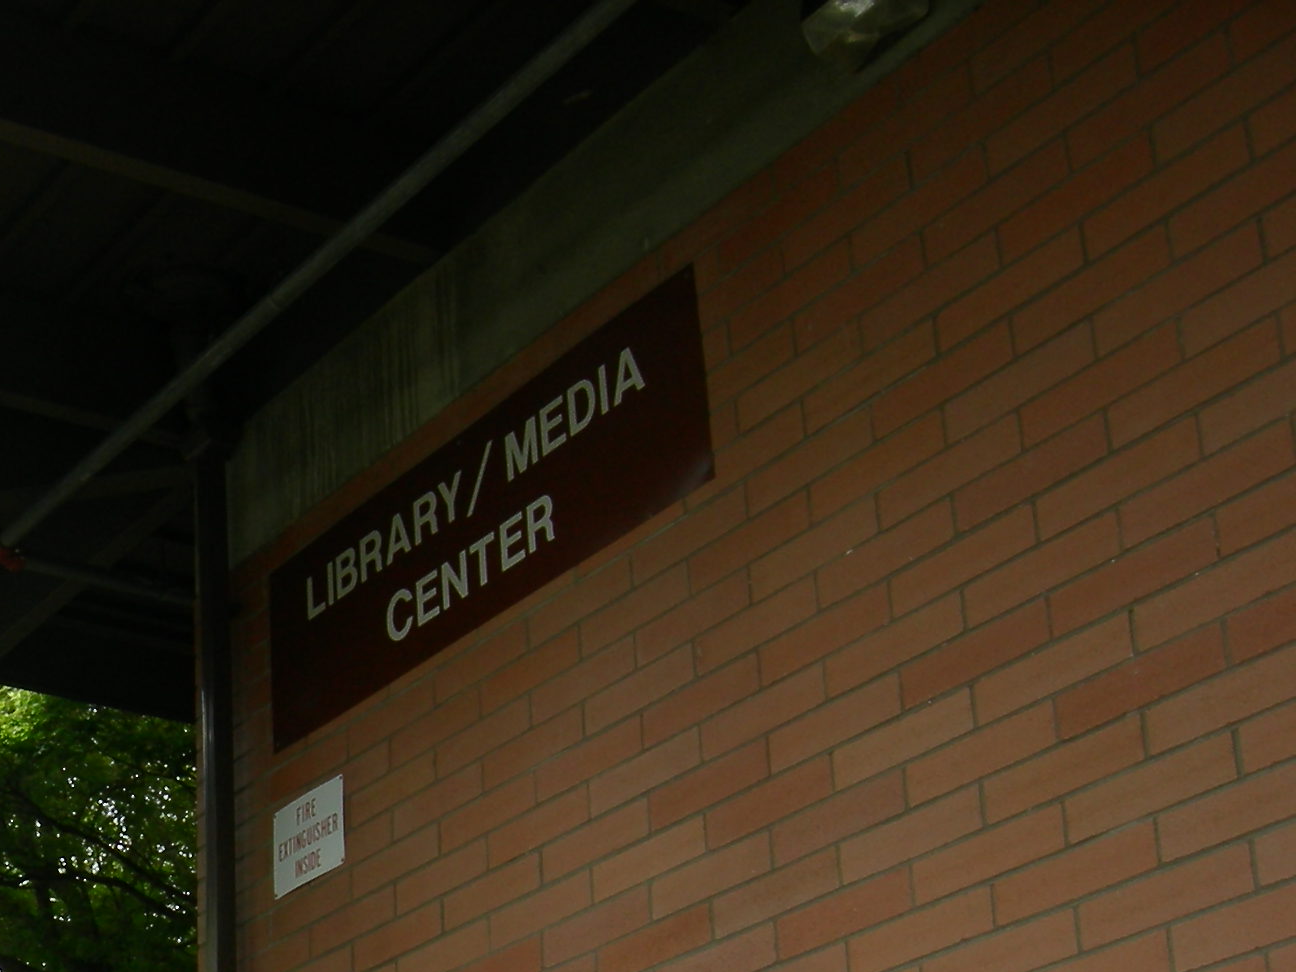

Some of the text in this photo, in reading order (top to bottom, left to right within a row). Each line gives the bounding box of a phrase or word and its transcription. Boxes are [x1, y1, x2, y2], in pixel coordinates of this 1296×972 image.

[504, 346, 646, 483] MEDIA
[386, 494, 556, 643] CENTER
[278, 812, 339, 862] EXTINGUISHER
[296, 798, 316, 826] FIRE
[294, 848, 321, 878] INSIDE
